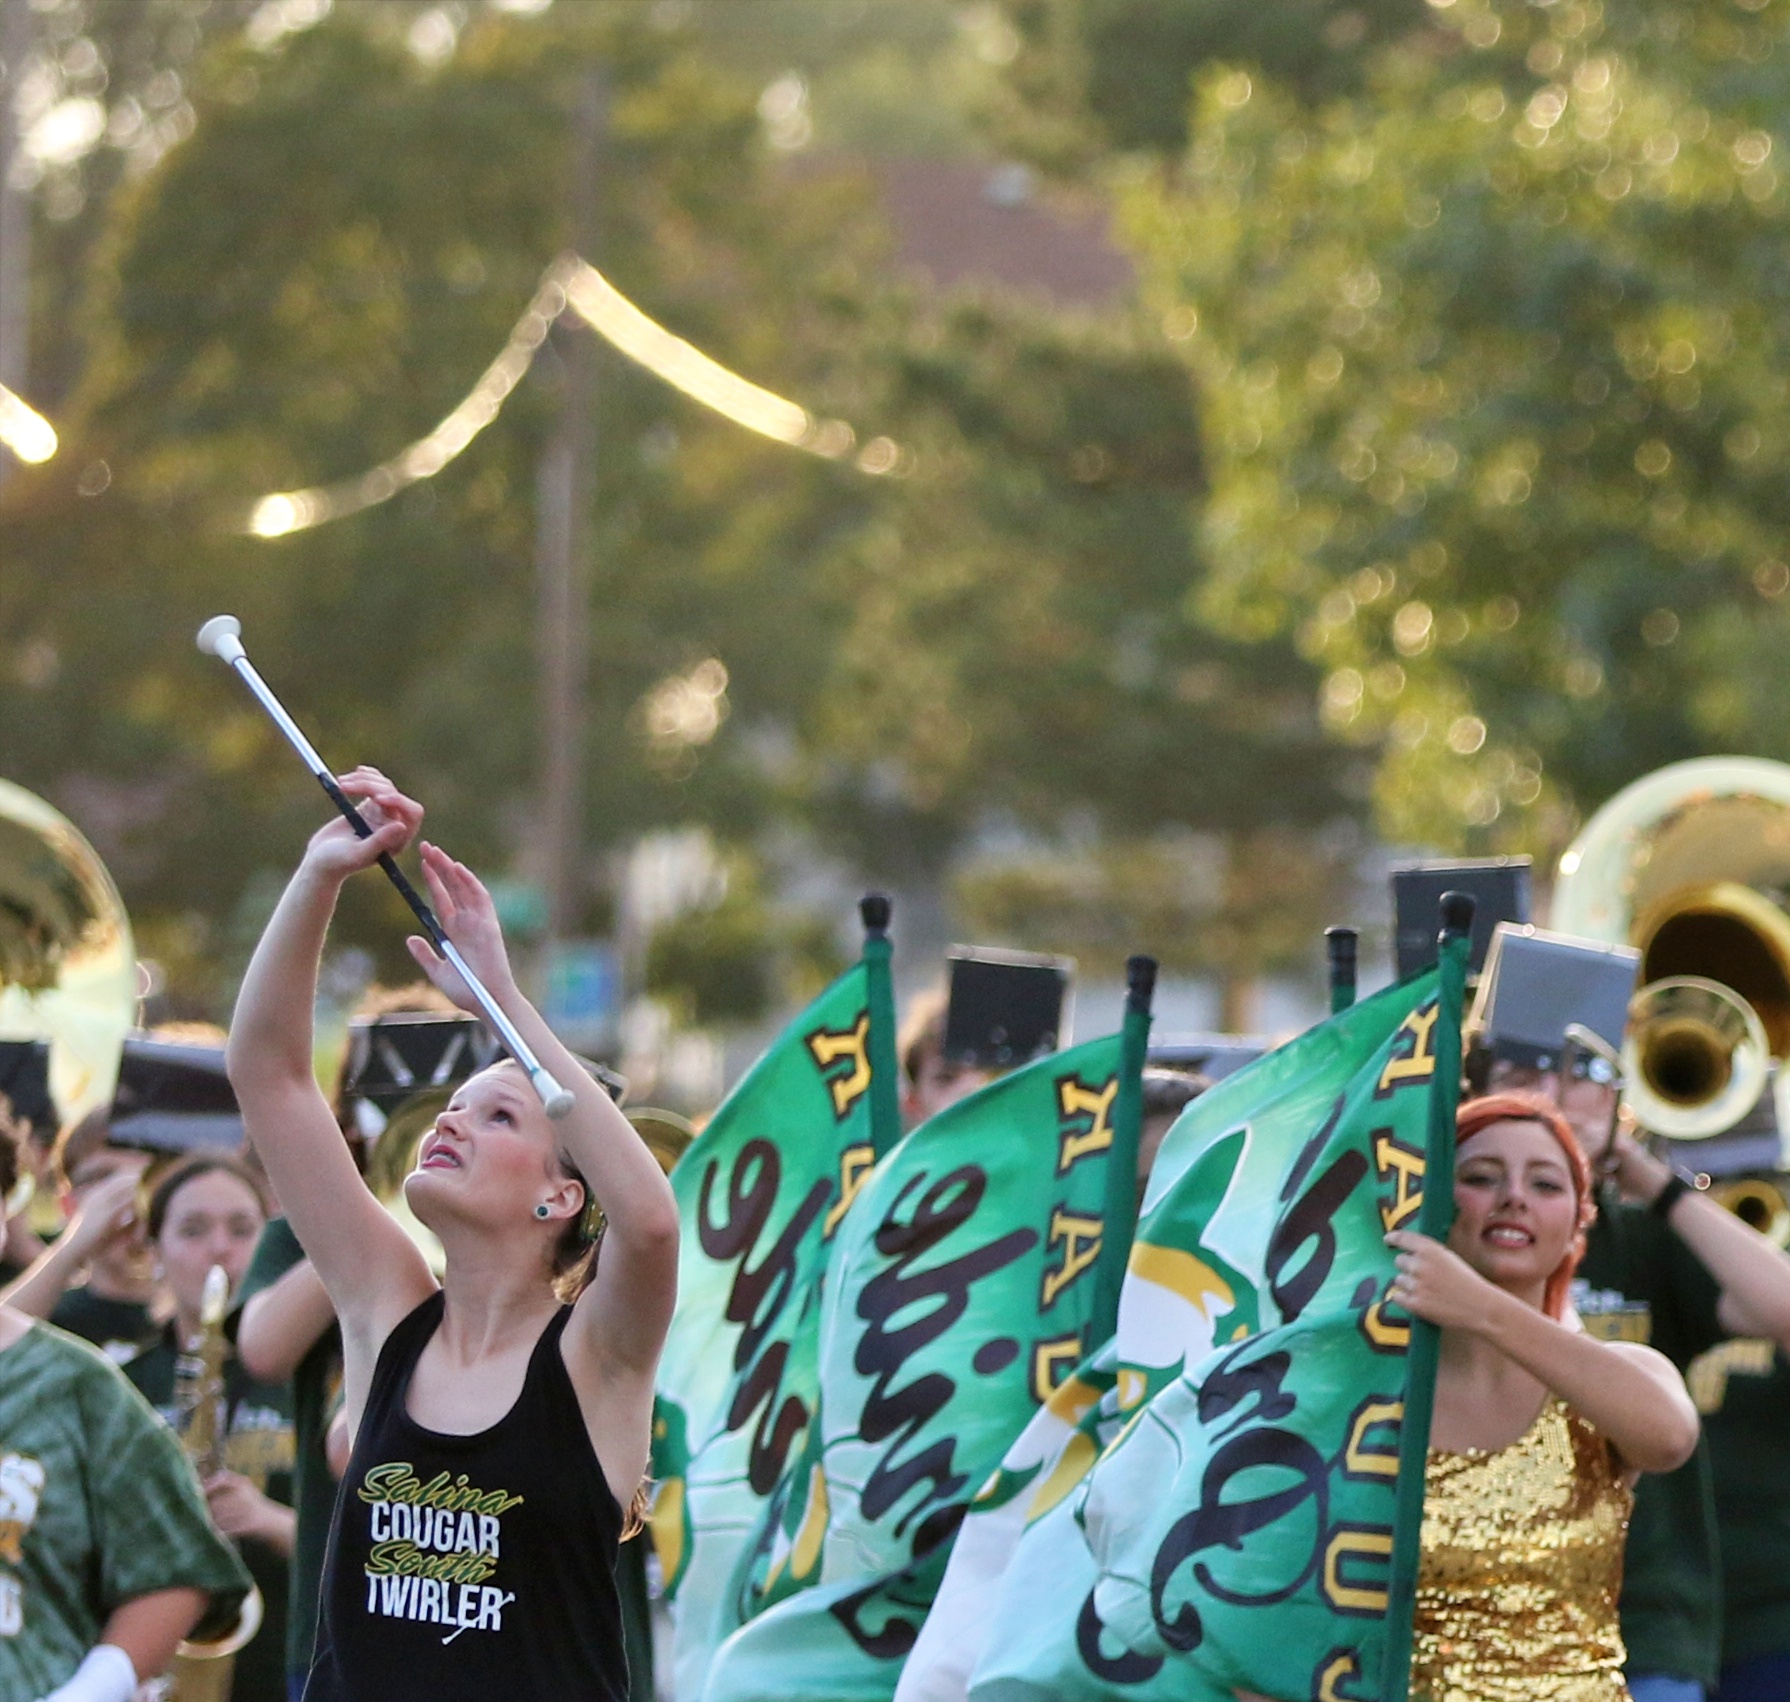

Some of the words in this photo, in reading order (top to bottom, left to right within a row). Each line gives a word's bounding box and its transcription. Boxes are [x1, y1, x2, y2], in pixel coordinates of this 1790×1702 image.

[358, 1462, 524, 1516] Salina
[371, 1500, 500, 1558] COUGAR
[364, 1538, 498, 1584] South
[365, 1570, 502, 1631] TWIRLER
